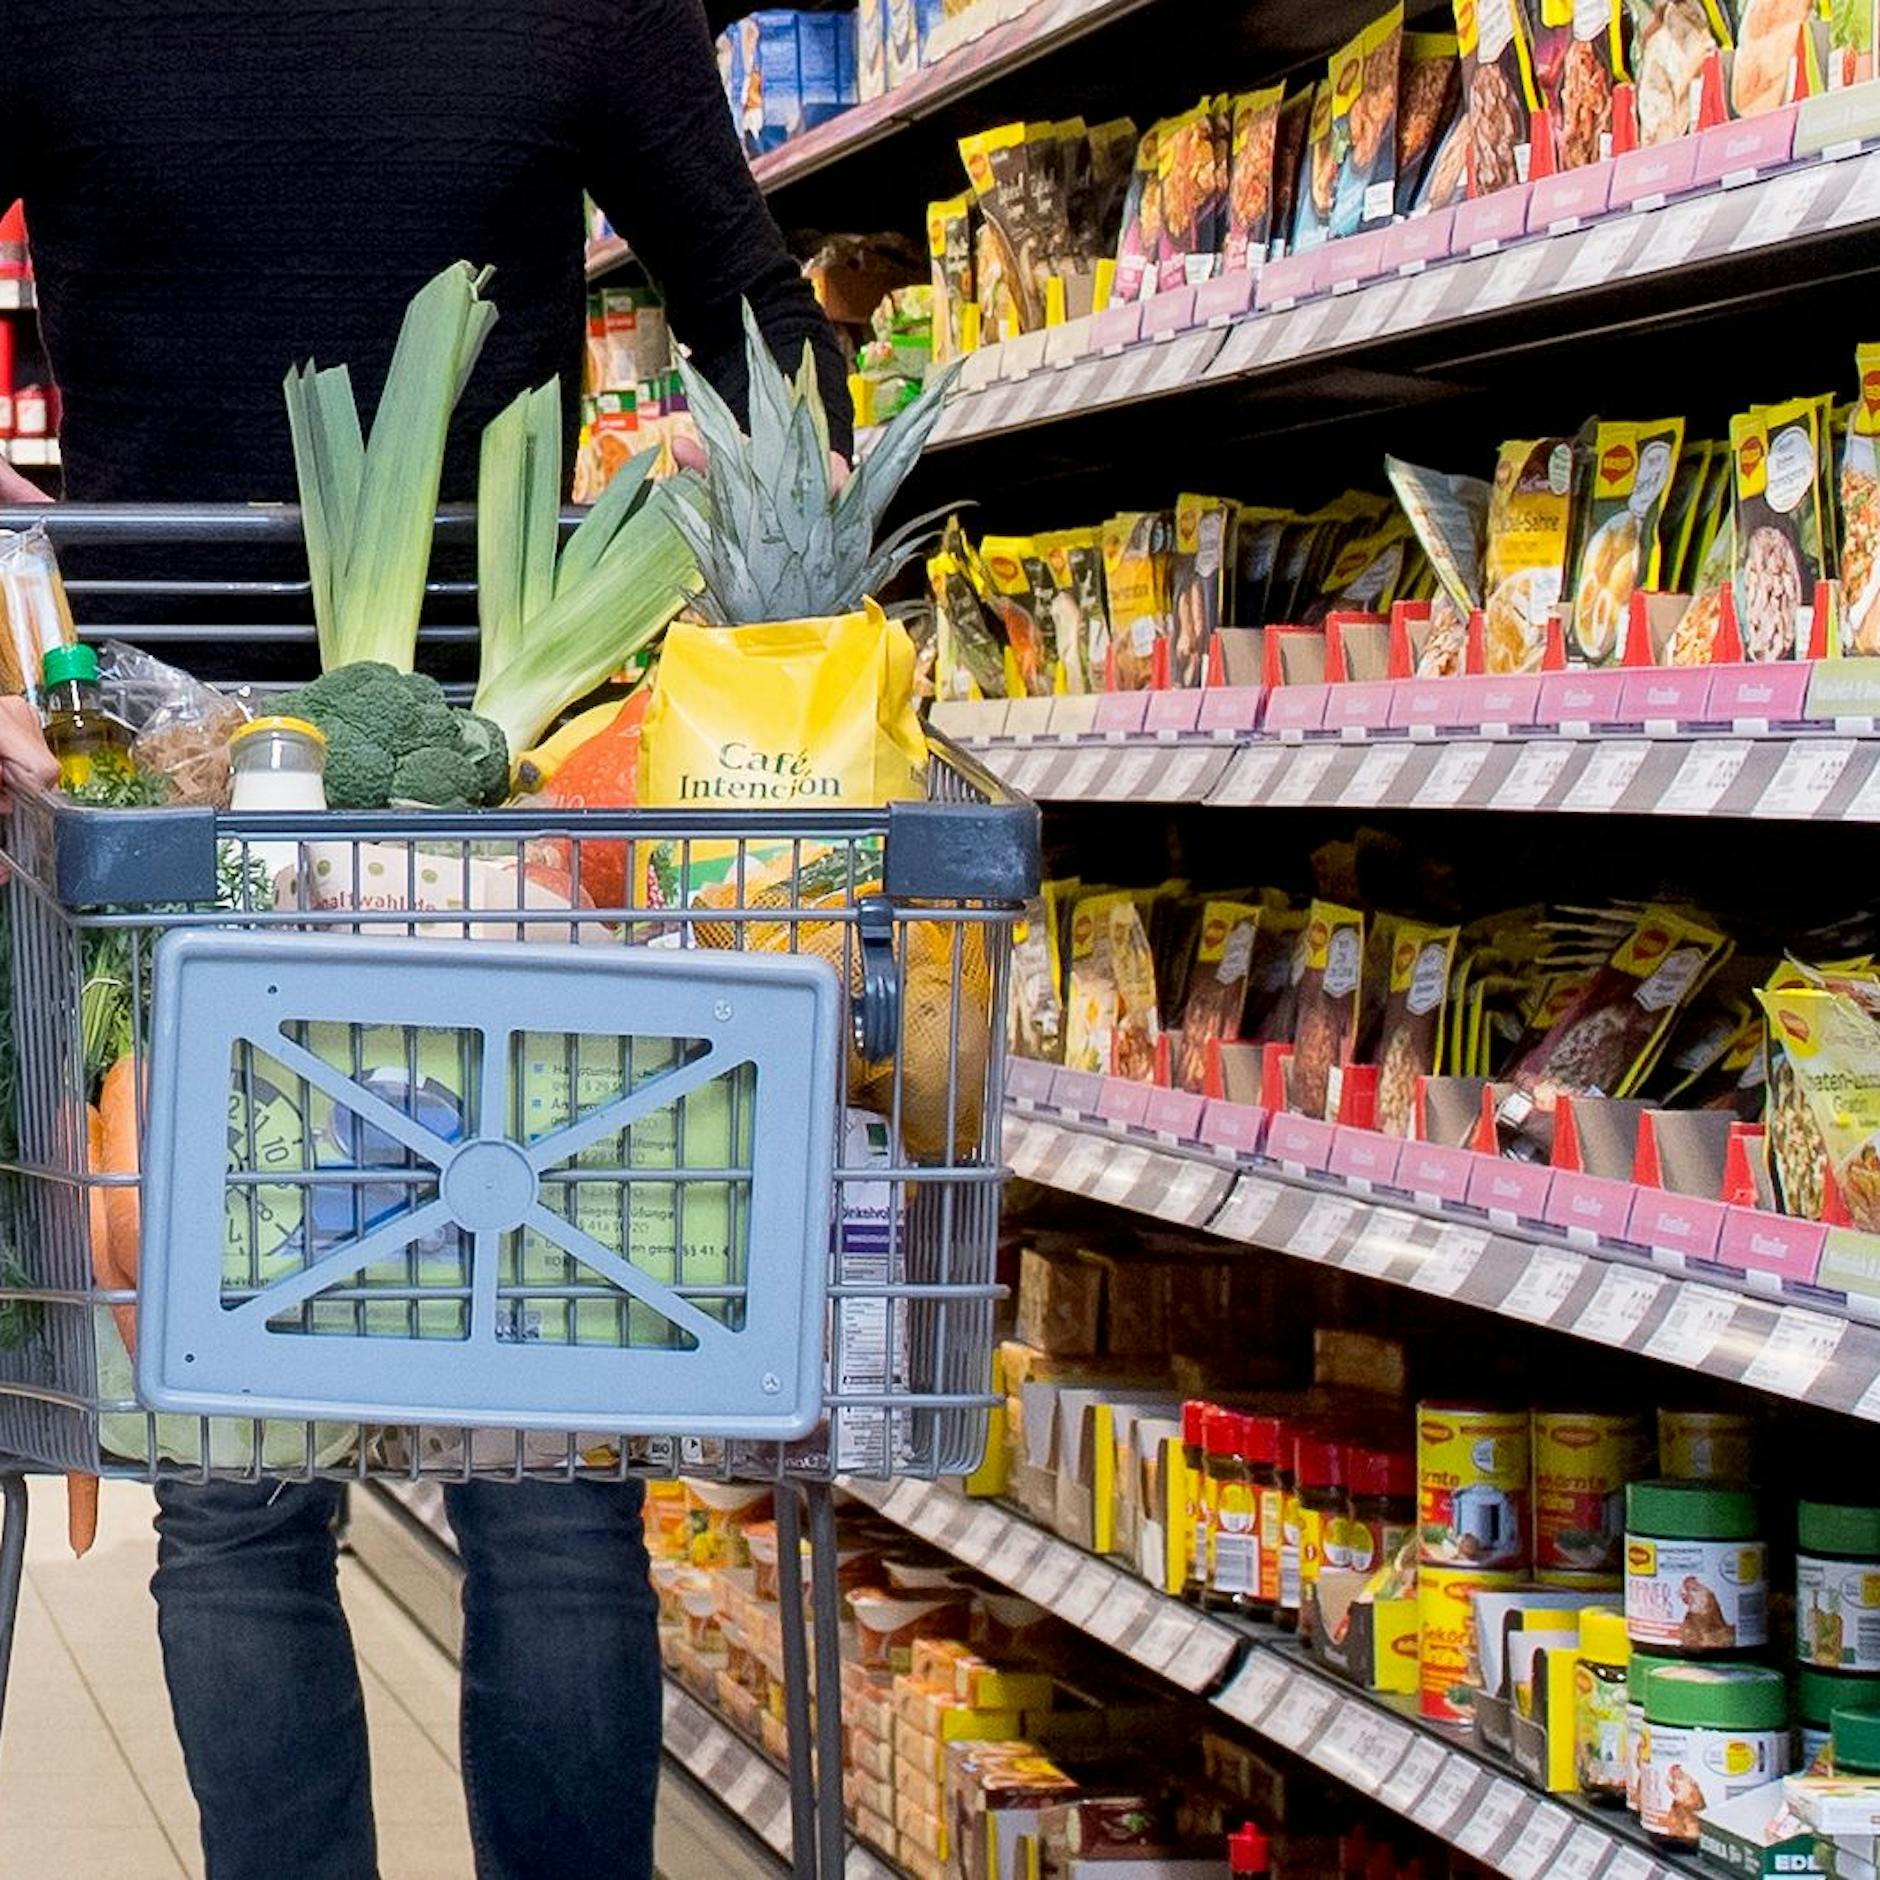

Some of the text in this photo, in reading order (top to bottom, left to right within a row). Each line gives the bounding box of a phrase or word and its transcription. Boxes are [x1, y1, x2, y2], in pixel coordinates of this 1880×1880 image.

[719, 742, 808, 776] Café
[679, 769, 841, 801] Intención
[261, 1135, 290, 1164] 10
